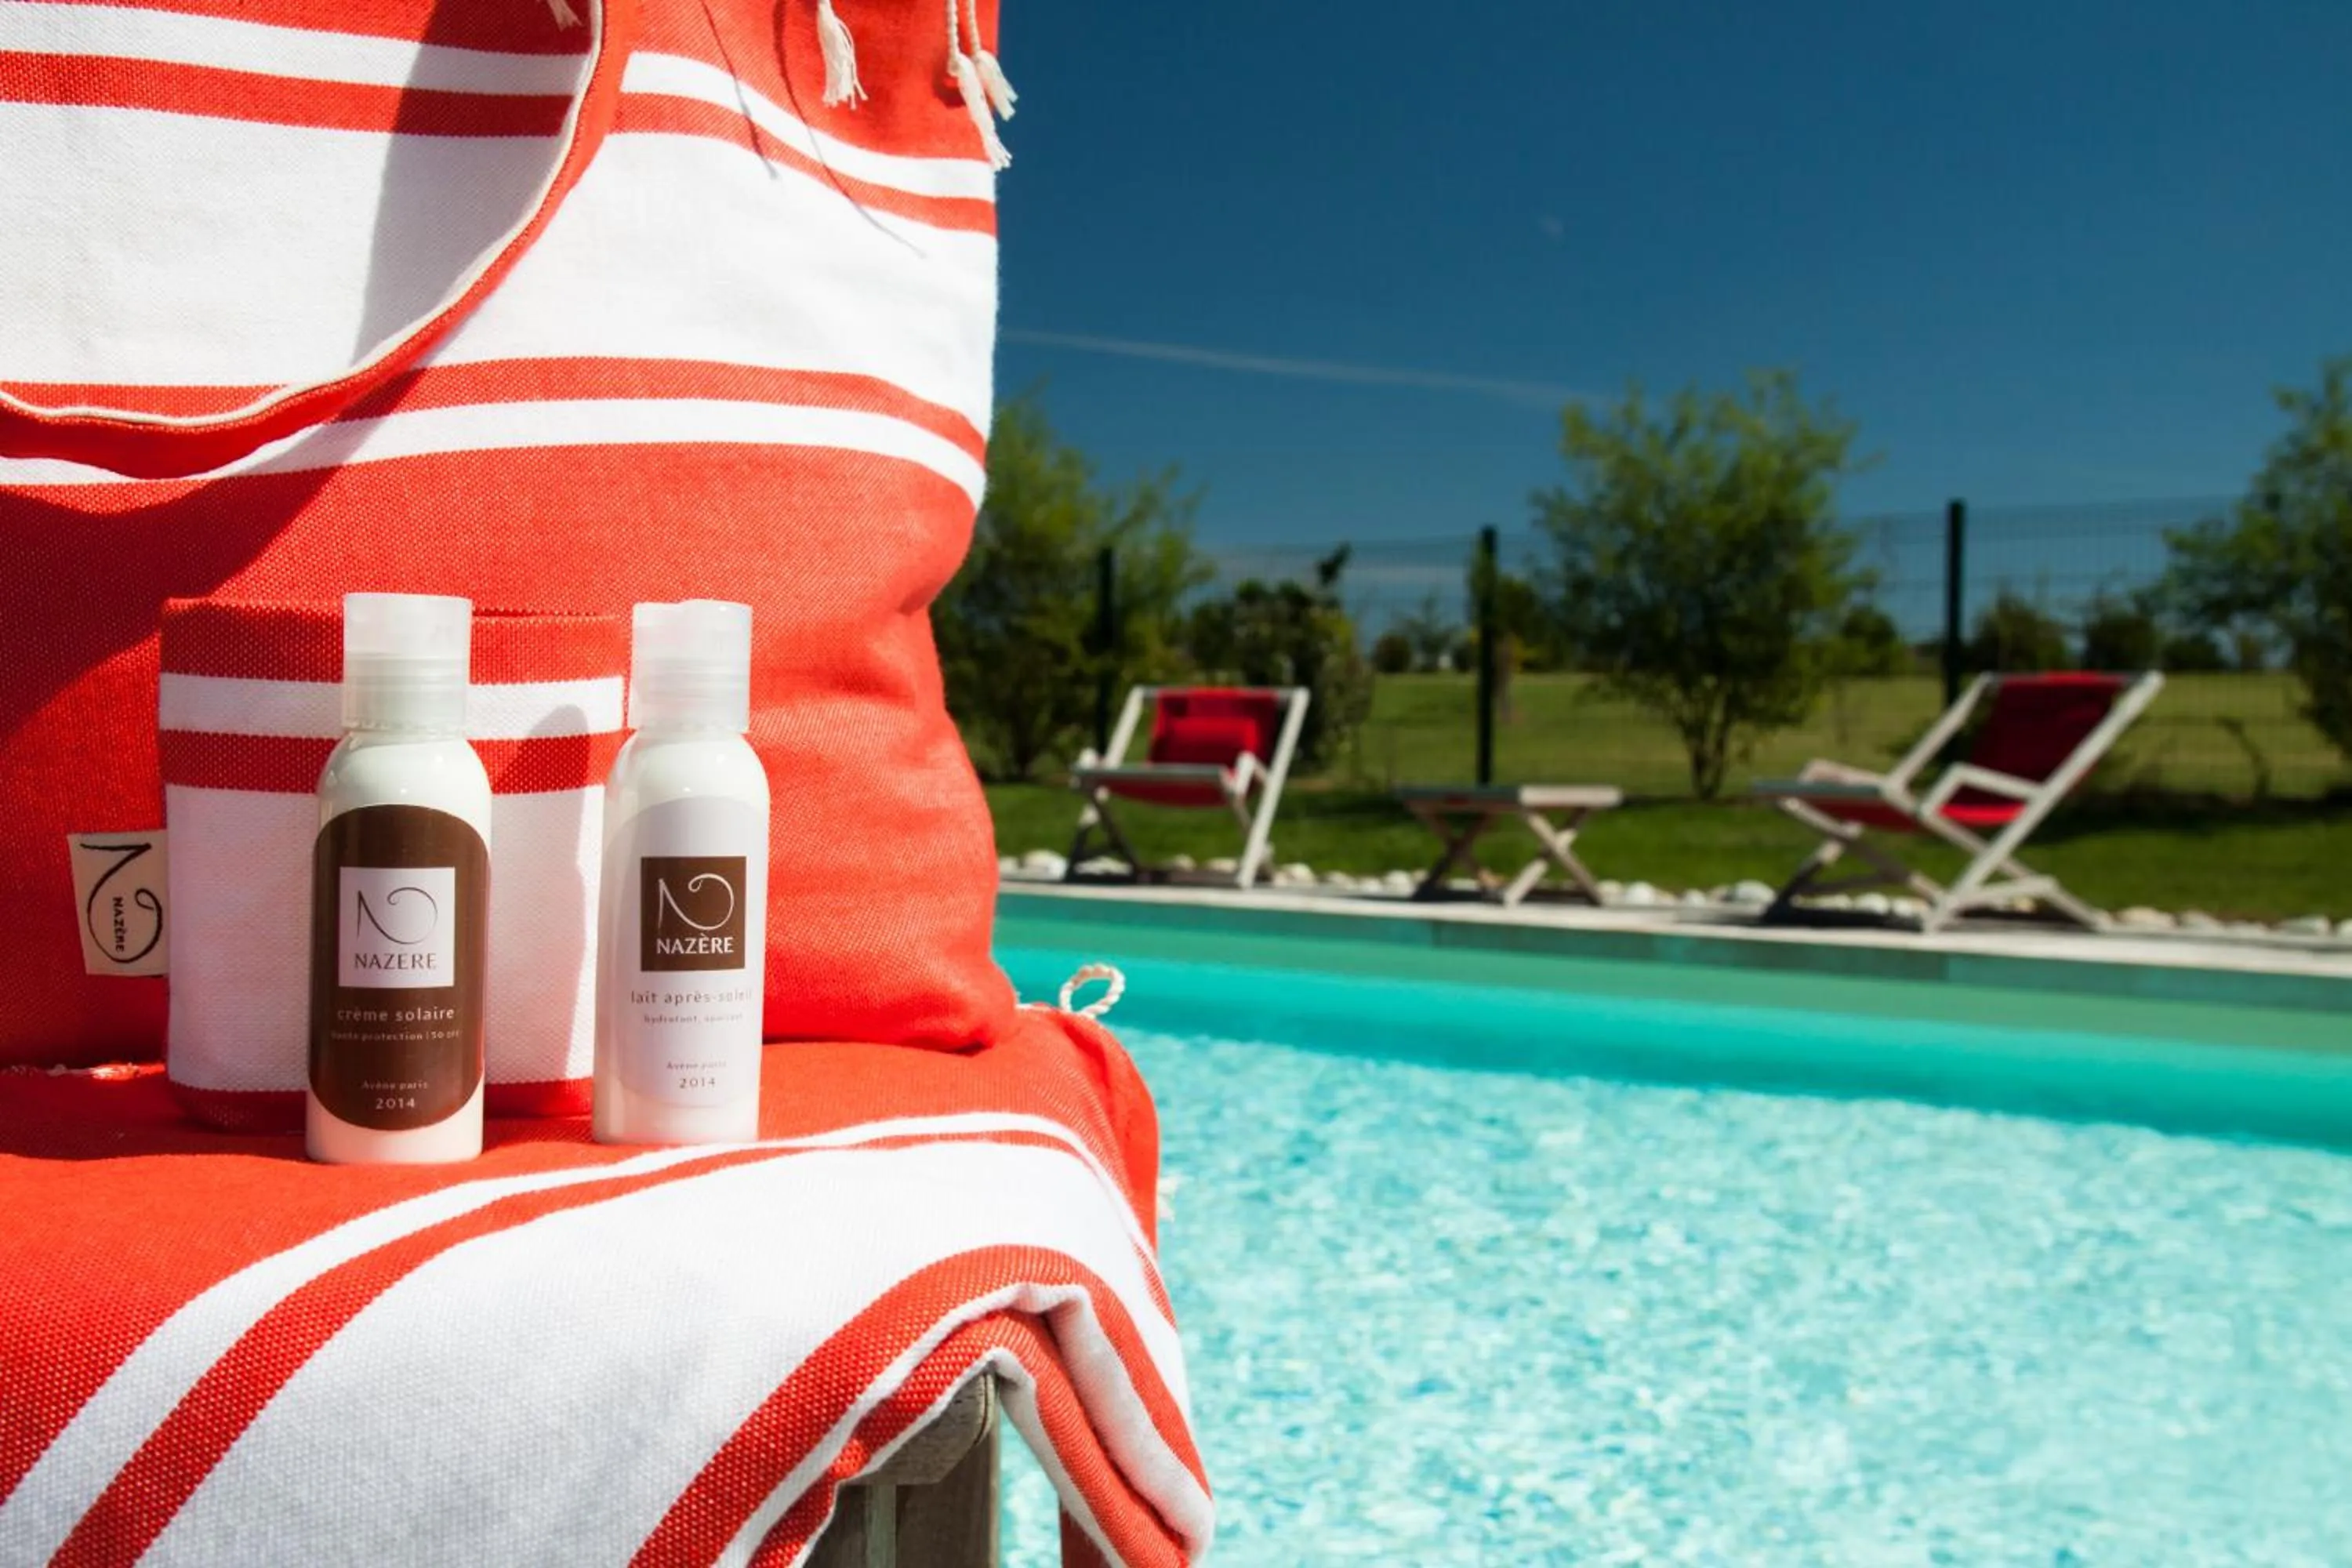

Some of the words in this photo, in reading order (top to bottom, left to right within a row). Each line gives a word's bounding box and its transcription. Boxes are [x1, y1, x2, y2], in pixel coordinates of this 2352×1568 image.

[657, 932, 734, 954] NAZÈRE
[631, 990, 658, 1004] lait
[337, 1006, 388, 1022] crème
[394, 1006, 455, 1022] solaire
[361, 1031, 423, 1042] protection
[679, 1077, 716, 1089] 2014
[376, 1098, 416, 1110] 2014
